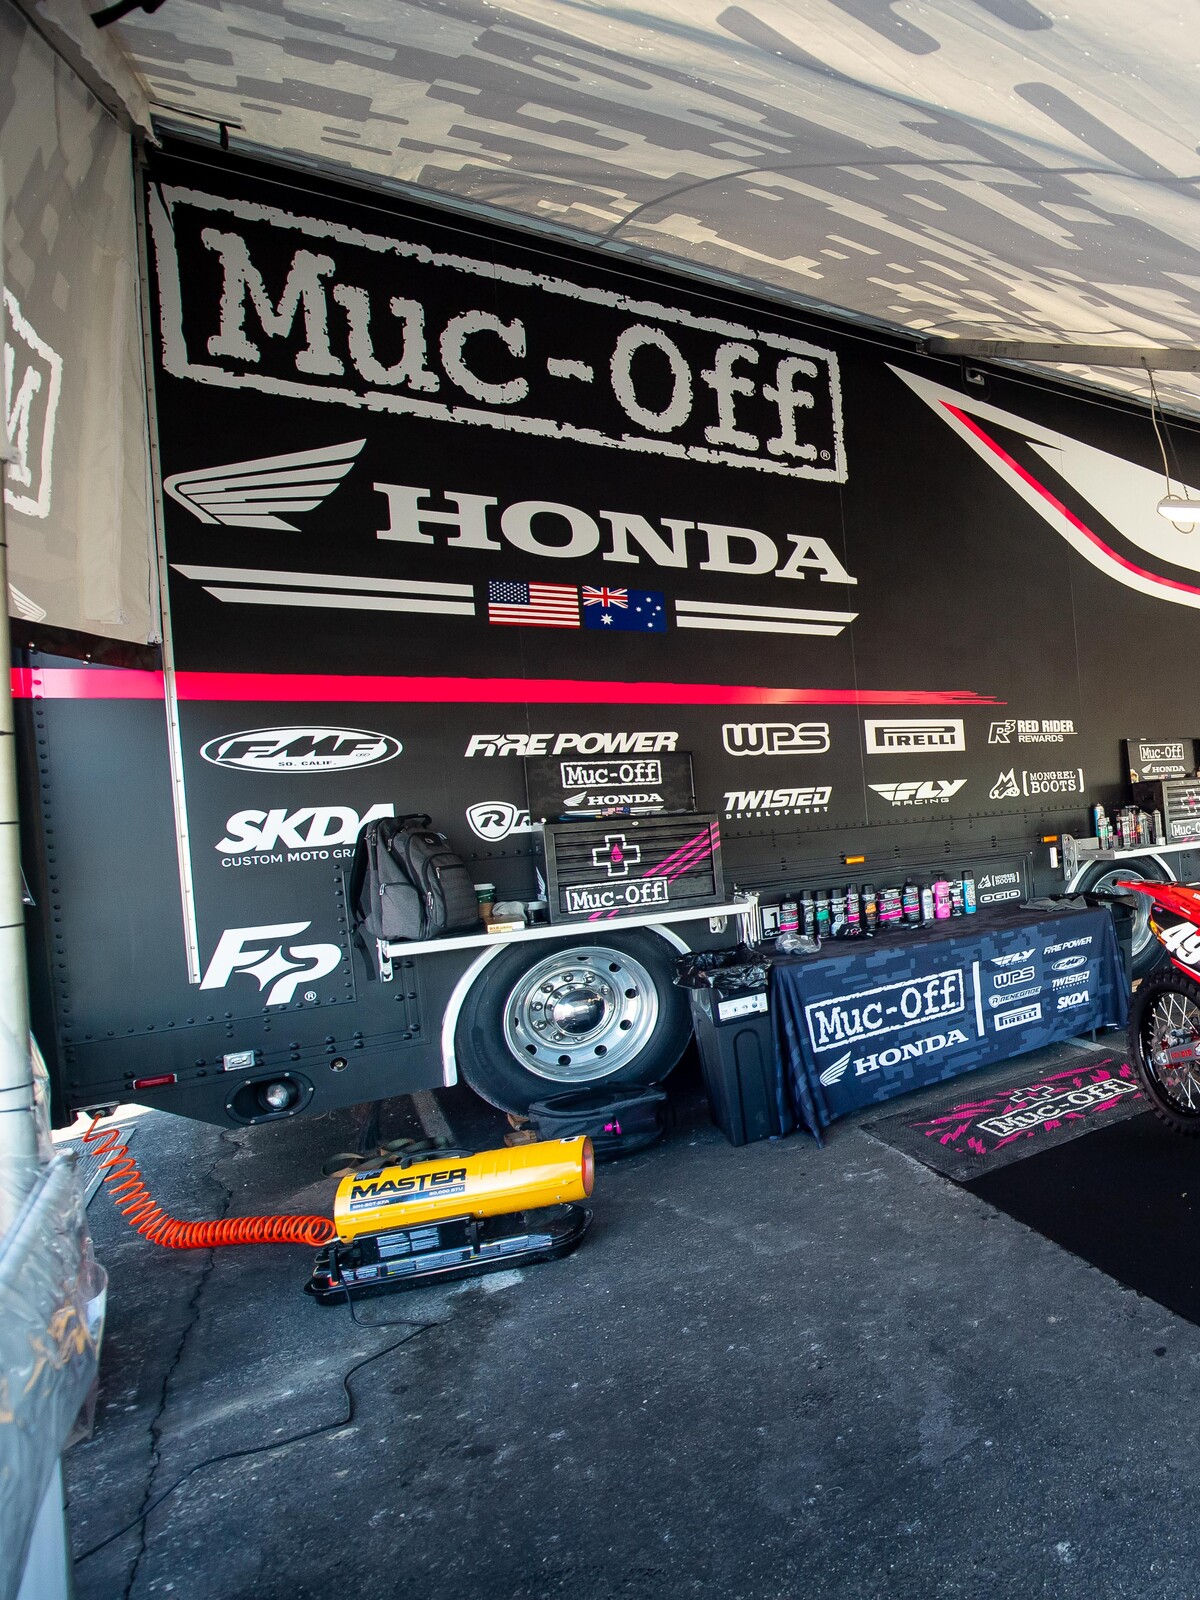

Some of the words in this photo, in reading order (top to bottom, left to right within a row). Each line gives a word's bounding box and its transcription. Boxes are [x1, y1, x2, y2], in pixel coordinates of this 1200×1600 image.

[201, 227, 818, 460] Muc-Off
[373, 482, 858, 585] HONDA
[1018, 719, 1040, 733] RED
[1043, 719, 1074, 733] RIDER
[464, 733, 554, 757] FIRE
[552, 731, 679, 755] POWER
[723, 724, 830, 756] WPS
[874, 725, 956, 747] PIRELLI
[1018, 733, 1064, 743] REWARDS
[218, 735, 382, 759] FMF
[1142, 746, 1182, 759] Muc-Off
[567, 764, 658, 784] Muc-Off
[1030, 771, 1076, 781] MONGREL
[1152, 765, 1186, 773] HONDA
[868, 778, 967, 800] FLY
[1030, 780, 1077, 794] BOOTS
[587, 793, 664, 806] HONDA
[892, 797, 949, 807] RACING
[725, 806, 829, 820] DEVELOPMENT
[221, 854, 283, 868] CUSTOM
[287, 850, 328, 862] MOTO
[571, 882, 664, 911] Muc-Off
[980, 890, 1020, 903] OGIO
[1043, 944, 1063, 955] FIRE
[1061, 936, 1092, 950] POWER
[990, 948, 1036, 966] FLY
[994, 966, 1034, 989] WPS
[1000, 987, 1041, 1002] RENEGADE
[1056, 990, 1090, 1010] SKDA
[815, 976, 956, 1044] Muc-Off
[998, 1007, 1037, 1026] PIRELLI
[853, 1029, 969, 1077] HONDA
[988, 1080, 1128, 1133] Muc-Off
[350, 1168, 468, 1200] MASTER
